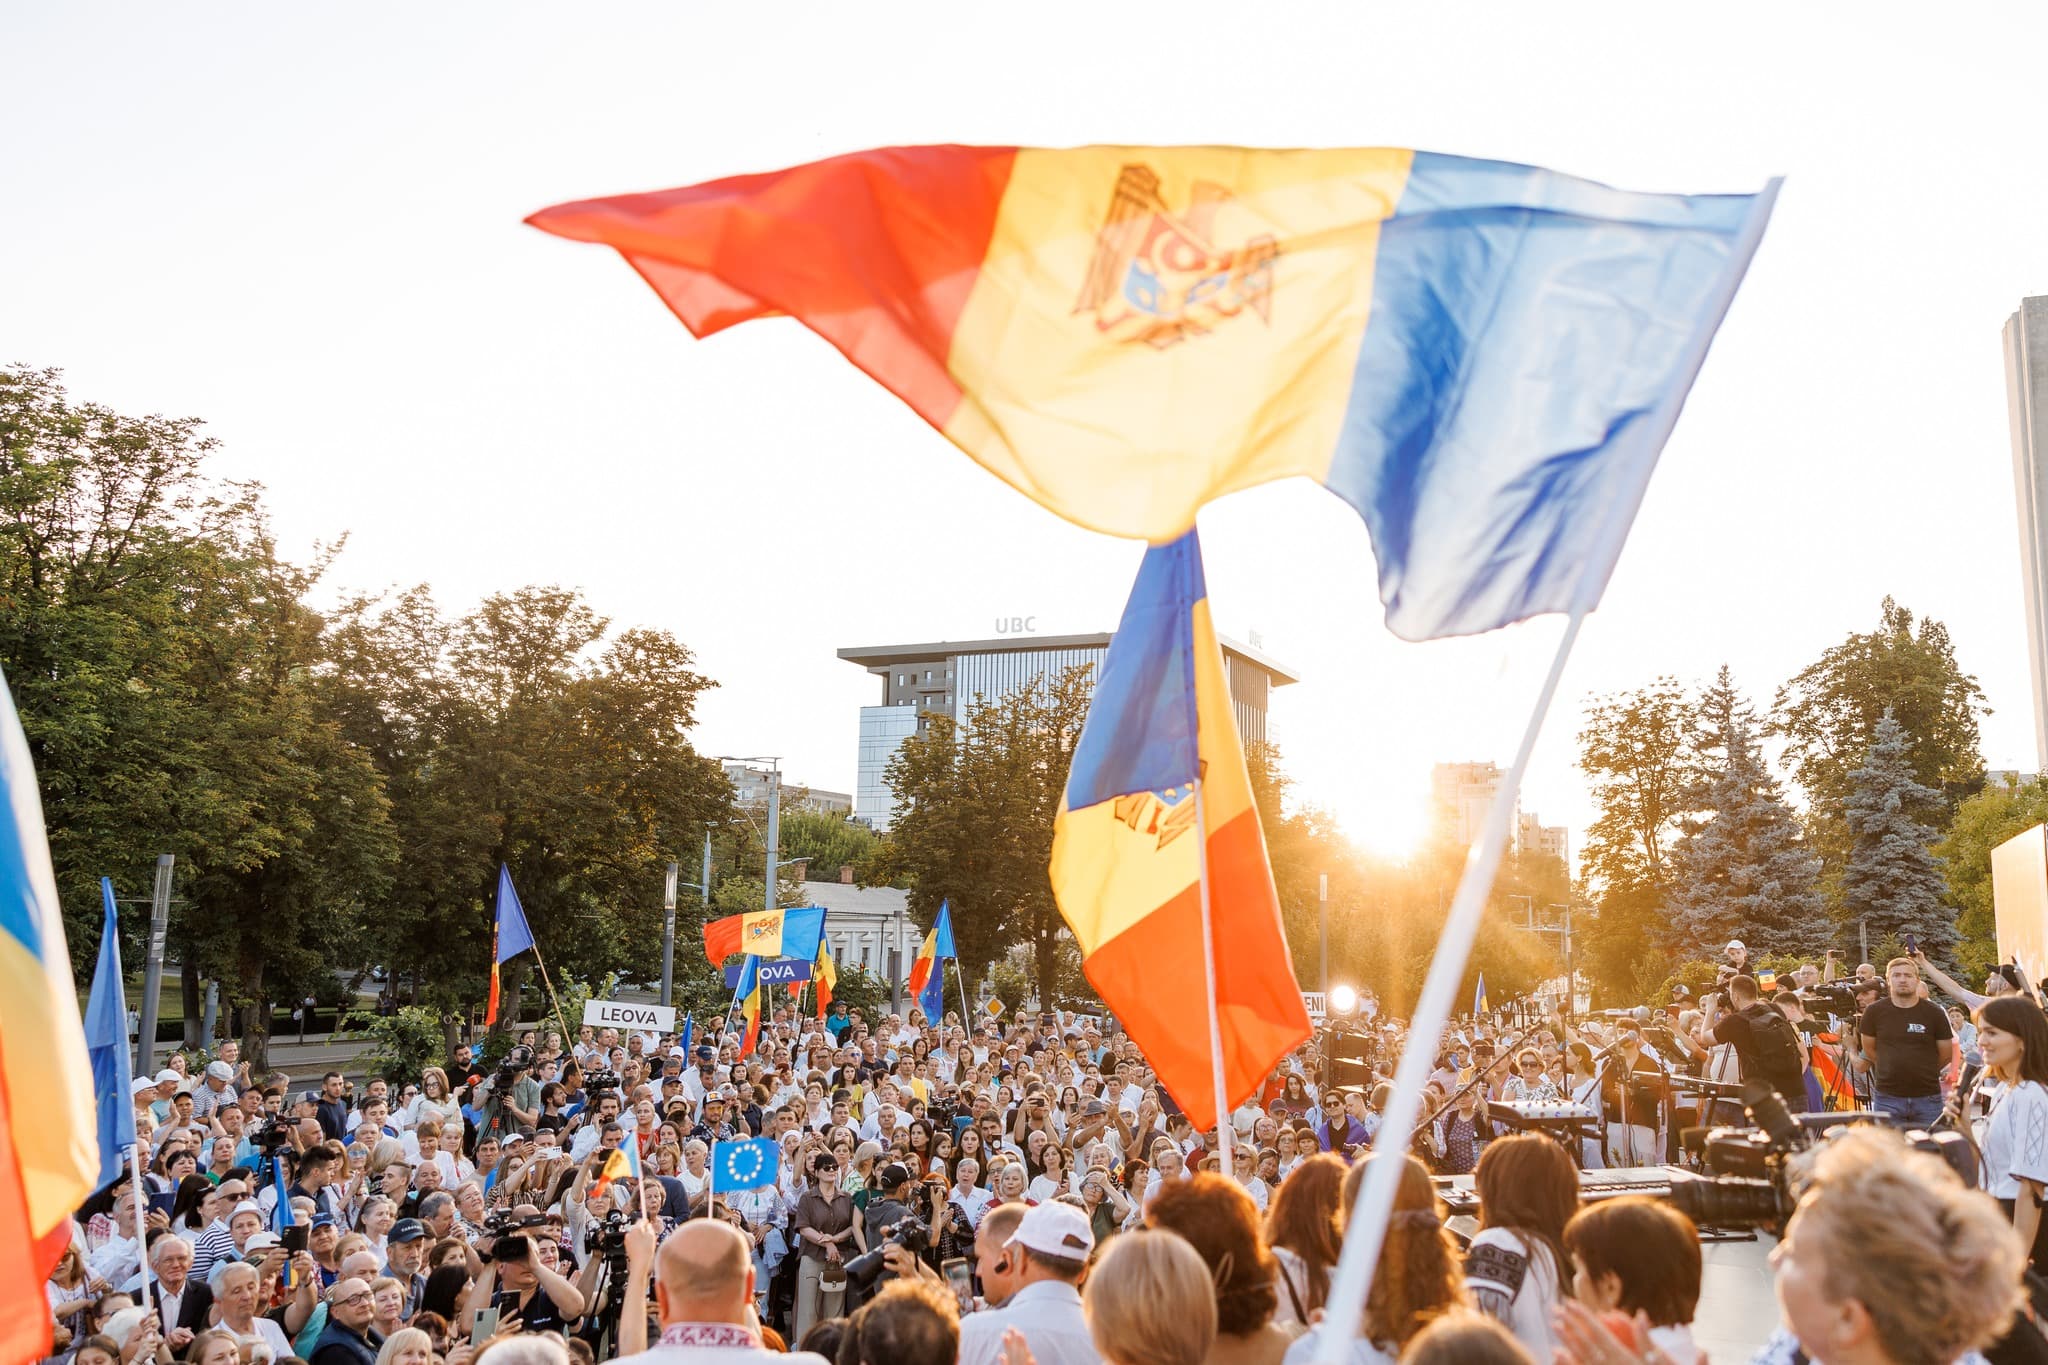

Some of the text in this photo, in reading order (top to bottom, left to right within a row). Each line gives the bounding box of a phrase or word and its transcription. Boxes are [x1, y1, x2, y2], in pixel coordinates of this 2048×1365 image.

[995, 615, 1036, 634] UBC
[759, 965, 795, 980] OVA
[1304, 996, 1324, 1012] ENI
[600, 1007, 658, 1025] LEOVA
